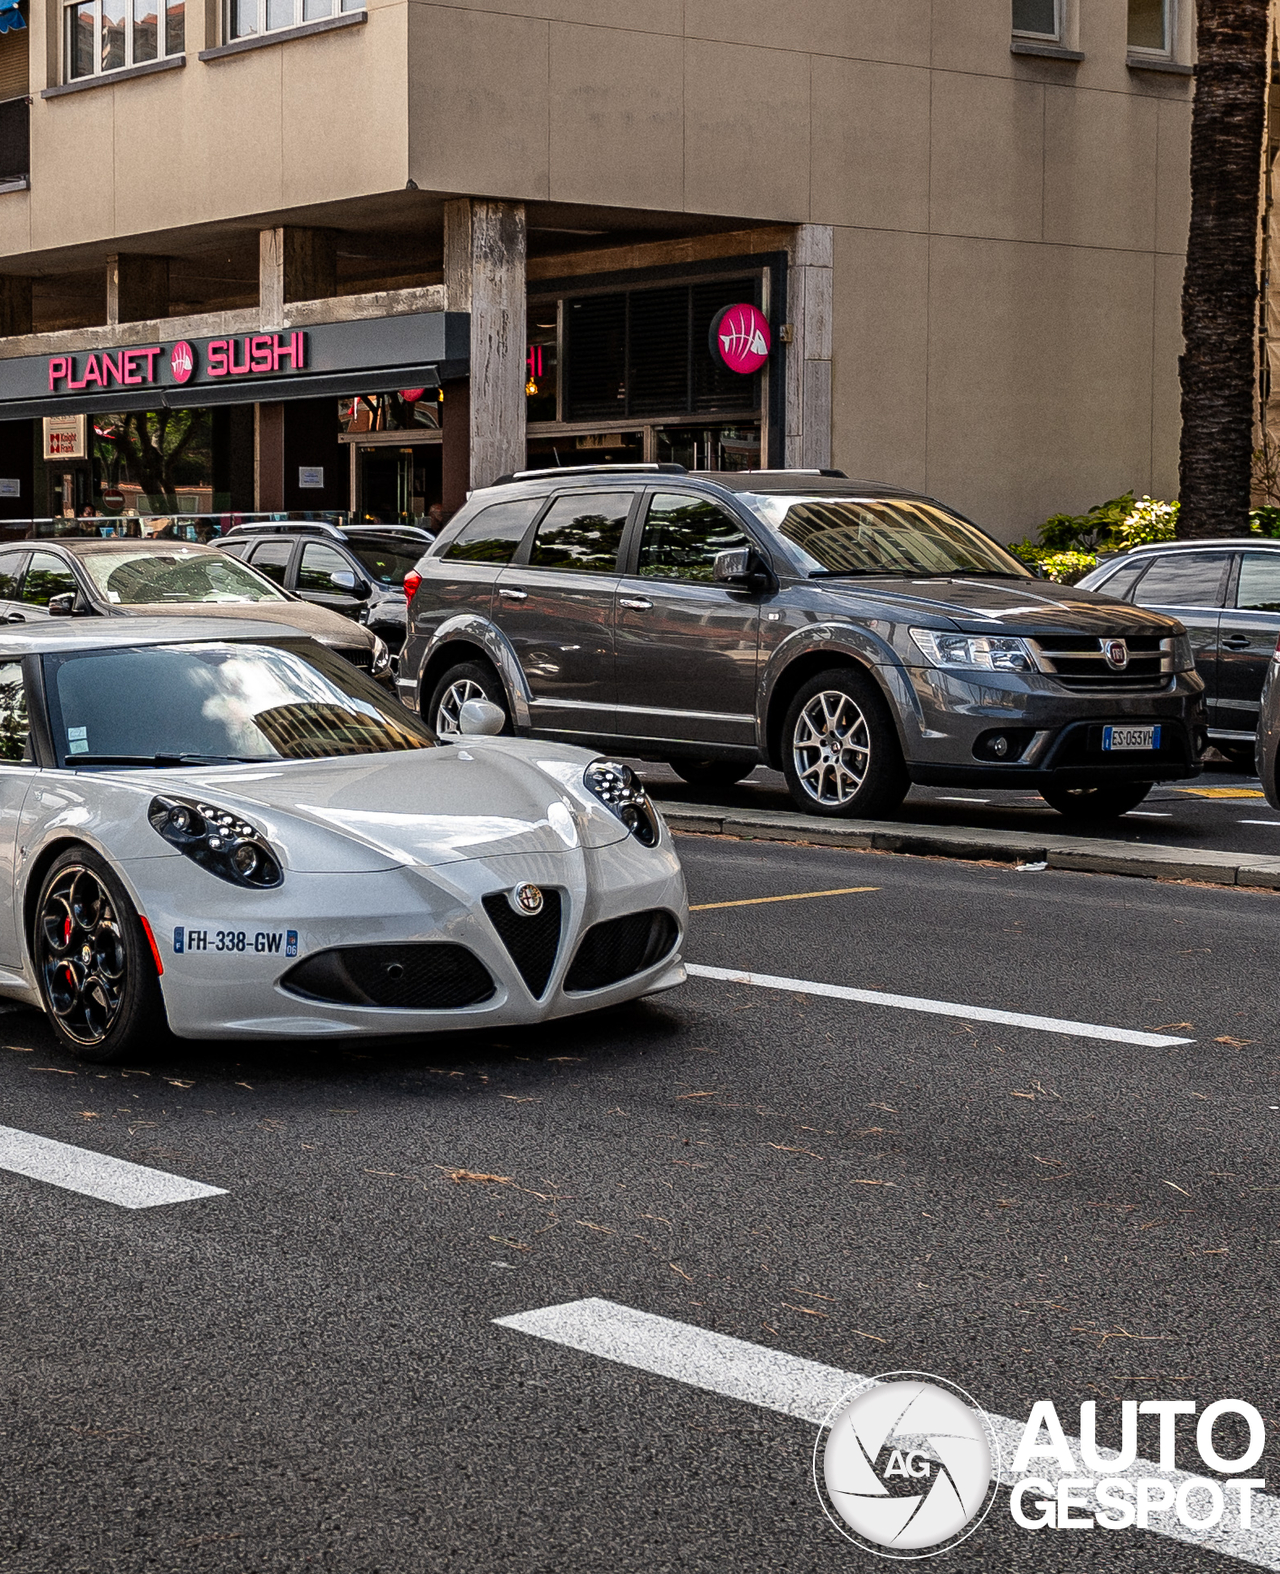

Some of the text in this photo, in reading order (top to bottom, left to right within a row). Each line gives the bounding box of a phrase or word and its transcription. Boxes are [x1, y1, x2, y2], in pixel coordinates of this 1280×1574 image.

[48, 331, 304, 391] PLANET SUSHI
[61, 432, 77, 444] Knight
[188, 930, 282, 953] FH-338-GW
[286, 945, 297, 955] 06
